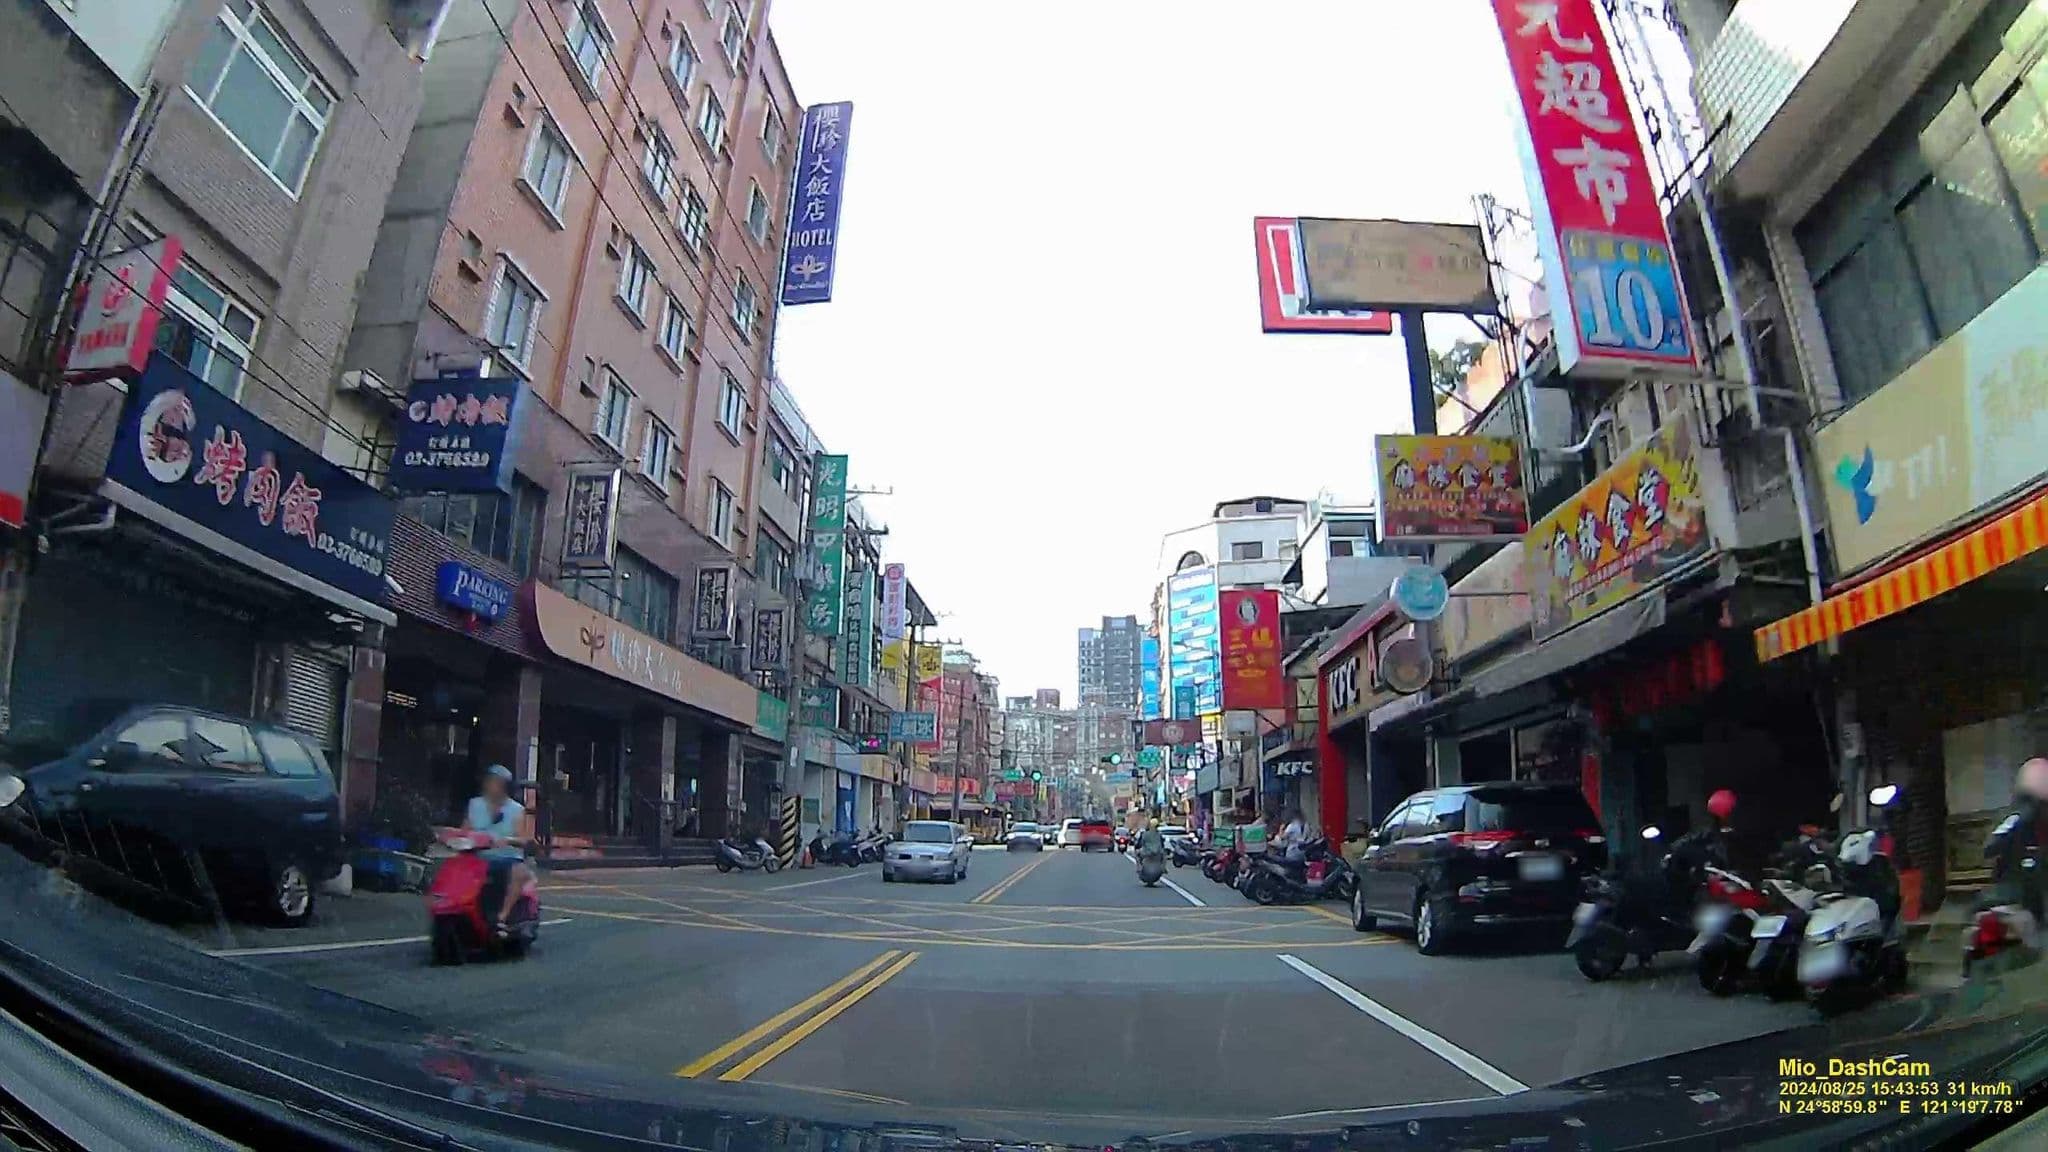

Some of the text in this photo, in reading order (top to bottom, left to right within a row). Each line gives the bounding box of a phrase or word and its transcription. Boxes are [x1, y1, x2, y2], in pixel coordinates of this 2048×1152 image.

[791, 228, 833, 248] HOTEL
[1576, 264, 1664, 350] 10
[193, 425, 322, 549] 烤肉飯
[451, 567, 509, 605] PARKING
[1277, 761, 1313, 776] KFC
